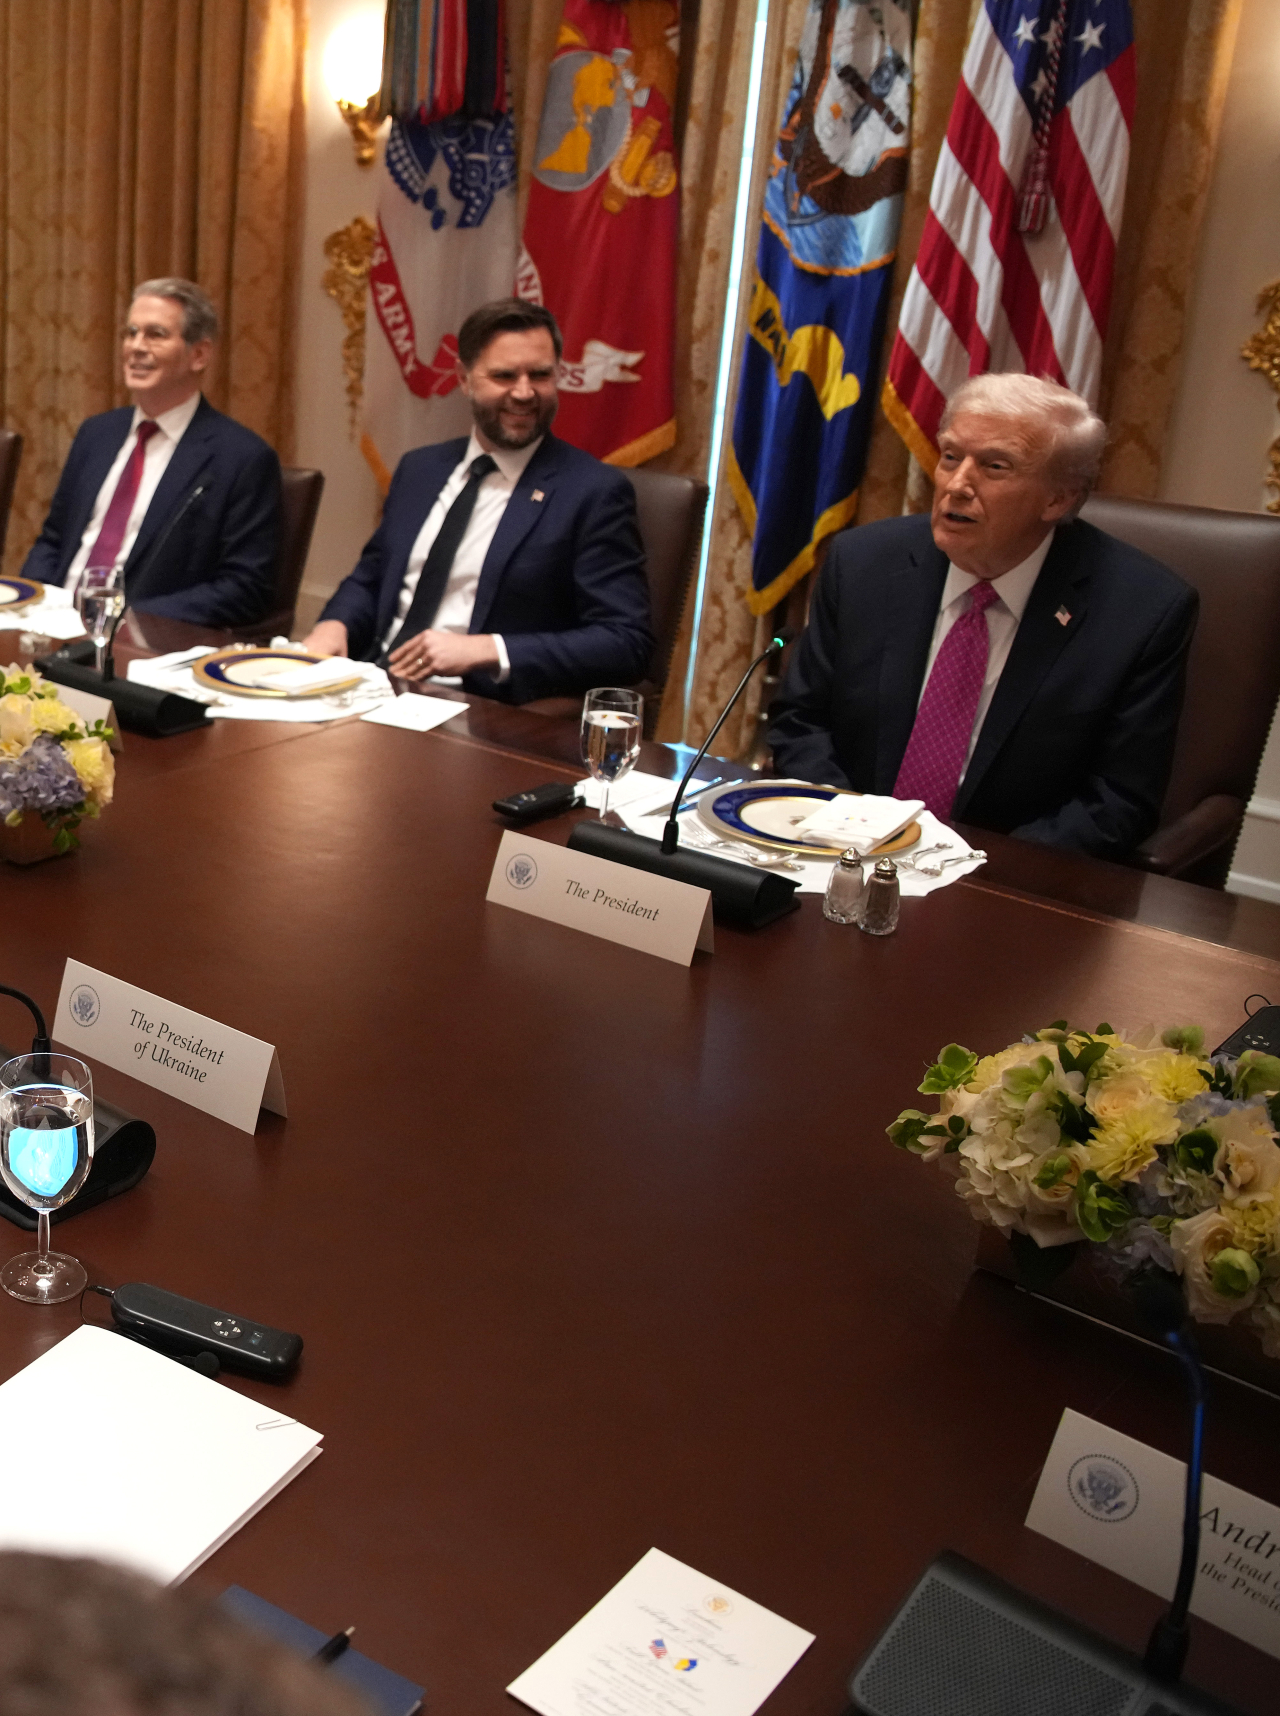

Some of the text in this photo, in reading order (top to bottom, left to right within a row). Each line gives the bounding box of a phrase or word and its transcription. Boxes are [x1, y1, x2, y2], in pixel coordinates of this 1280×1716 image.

[374, 280, 418, 377] ARMY
[565, 879, 660, 922] The President
[129, 1009, 225, 1065] The President
[133, 1041, 207, 1083] of Ukraine
[1199, 1506, 1280, 1560] Andr
[1200, 1561, 1228, 1584] the
[1223, 1551, 1271, 1585] Head
